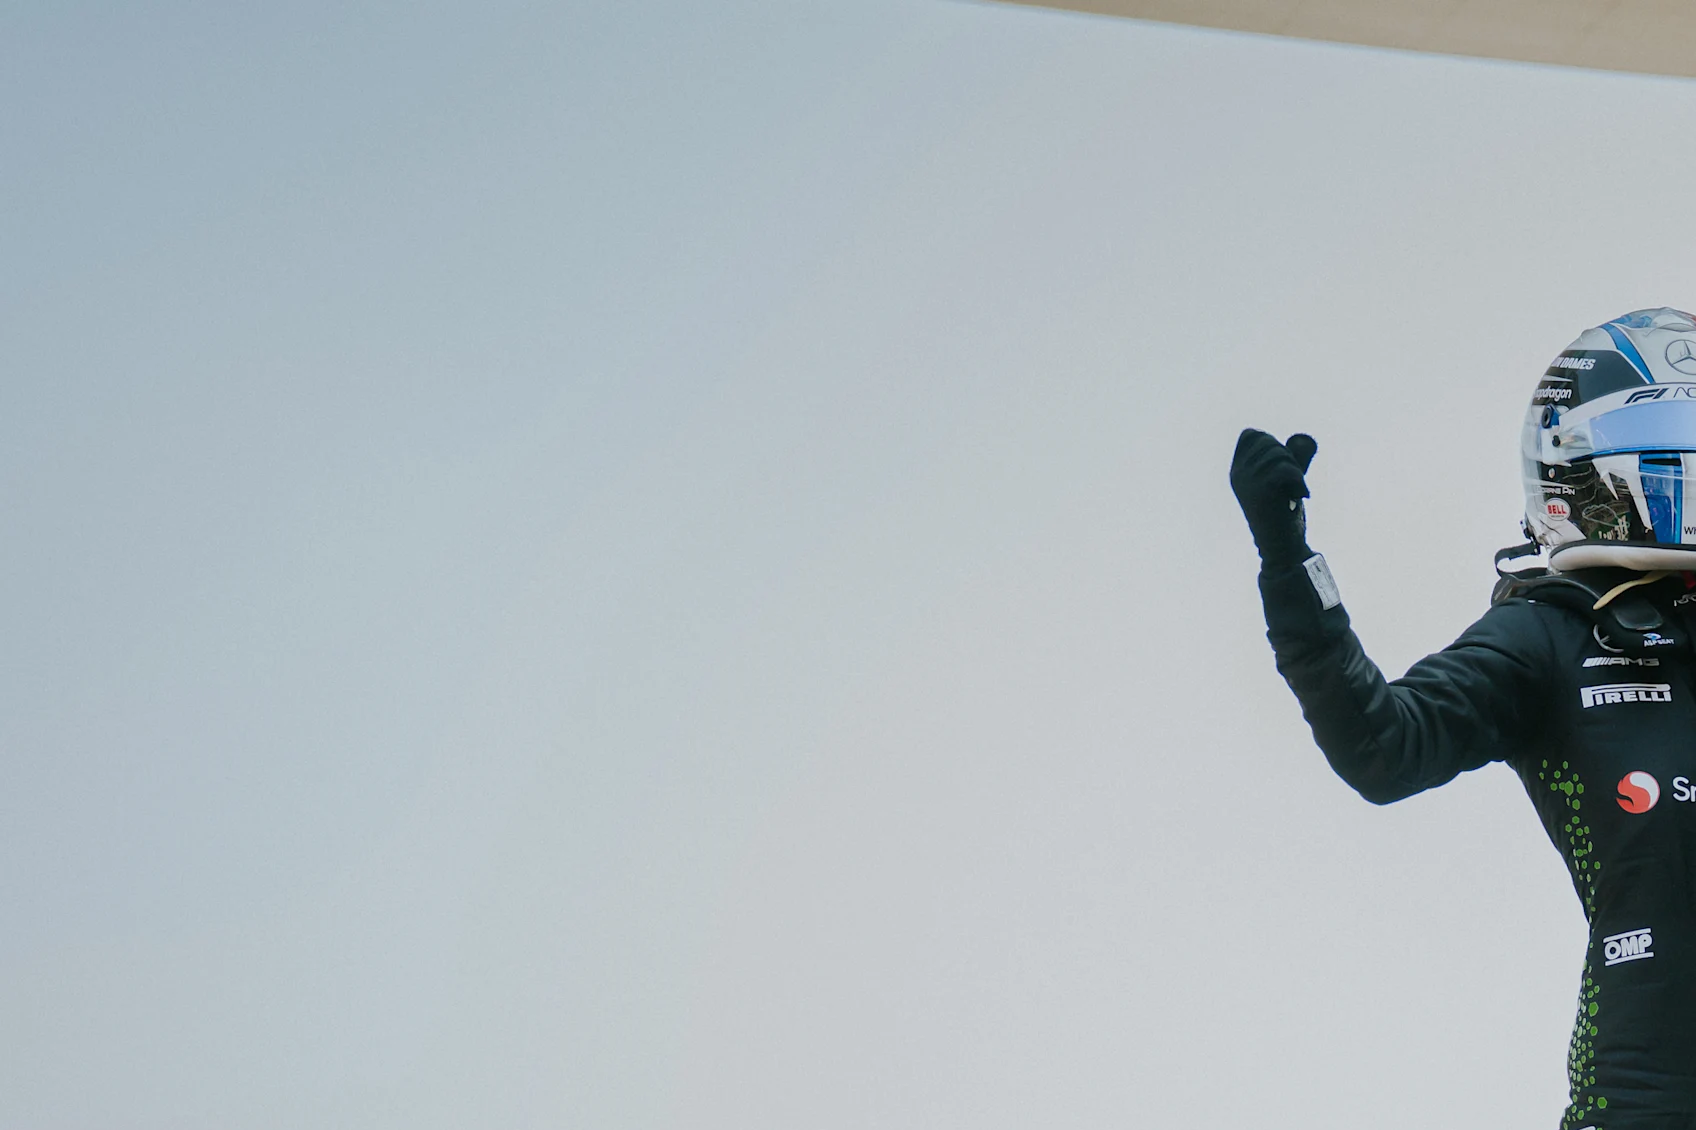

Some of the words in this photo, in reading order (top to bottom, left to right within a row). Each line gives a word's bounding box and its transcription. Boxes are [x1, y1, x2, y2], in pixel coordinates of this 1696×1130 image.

[1560, 357, 1597, 371] DAMES
[1624, 387, 1670, 405] F1
[1547, 504, 1568, 515] BELL
[1608, 656, 1660, 667] AMG
[1580, 683, 1673, 709] PIRELLI
[1604, 933, 1653, 961] OMP
